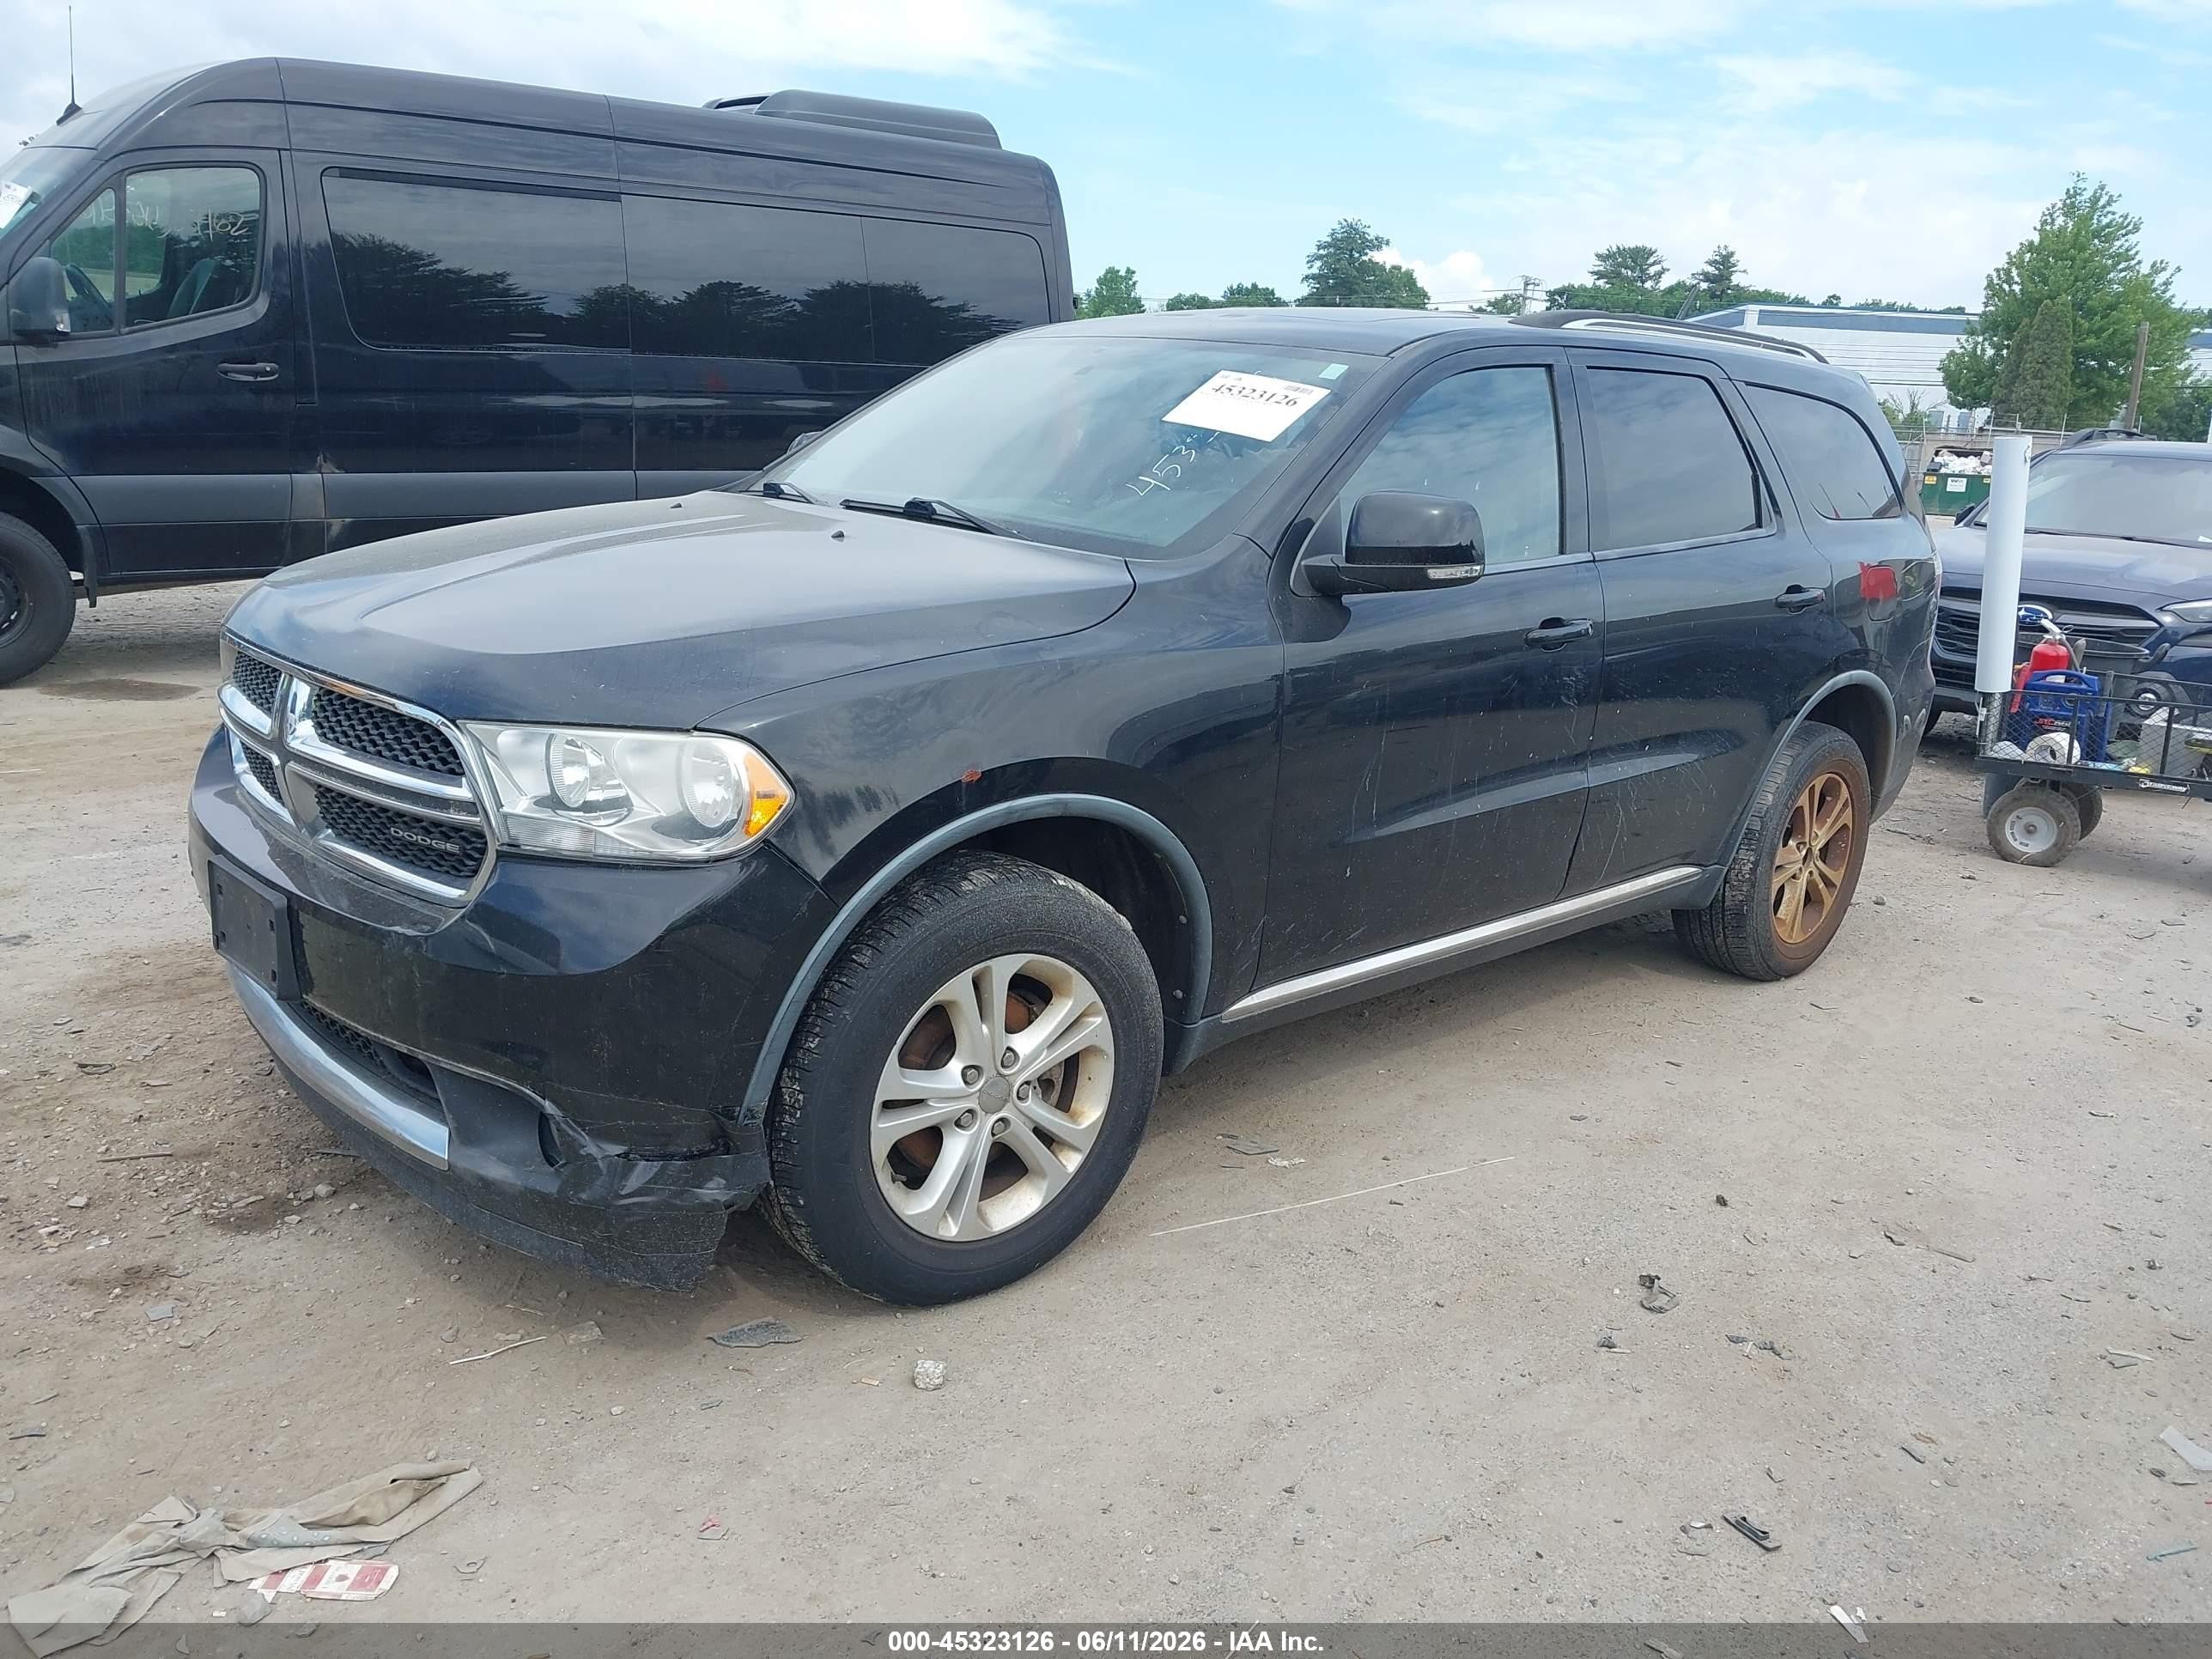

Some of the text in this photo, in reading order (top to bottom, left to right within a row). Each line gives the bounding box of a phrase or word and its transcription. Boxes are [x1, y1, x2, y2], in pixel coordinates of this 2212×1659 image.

[1212, 384, 1300, 407] 45323126
[1126, 433, 1198, 496] 453
[390, 827, 461, 854] DODGE
